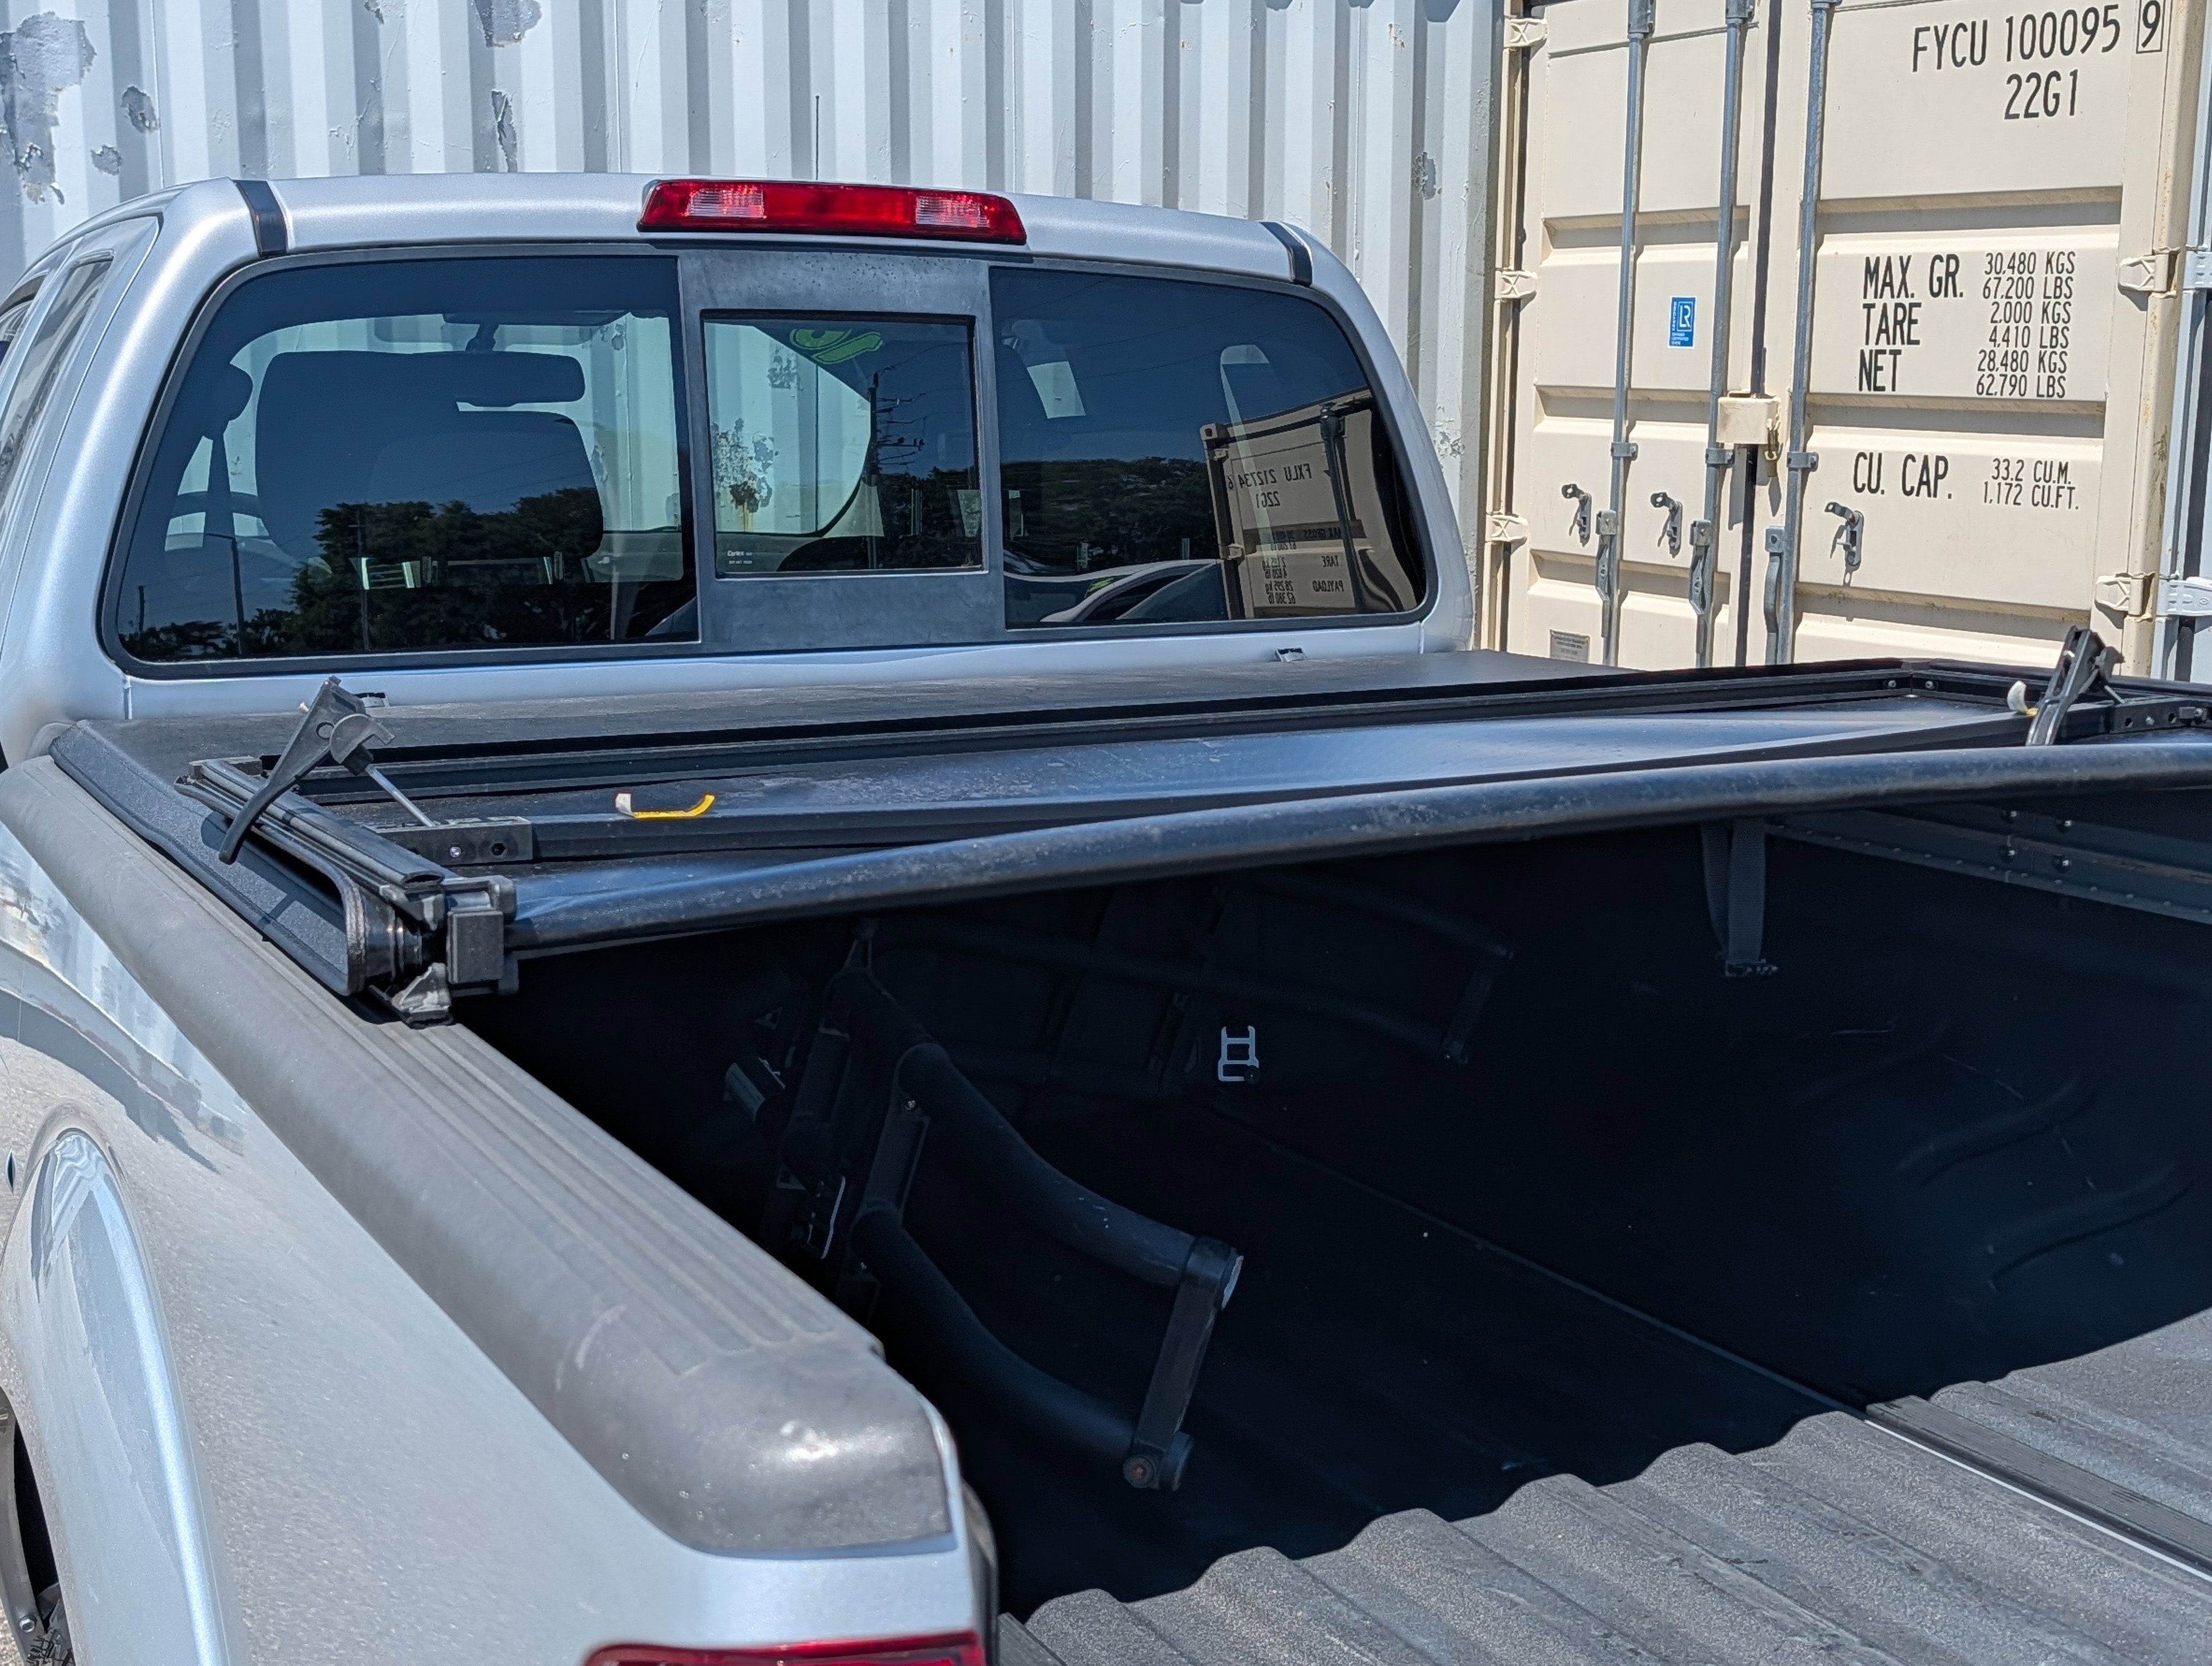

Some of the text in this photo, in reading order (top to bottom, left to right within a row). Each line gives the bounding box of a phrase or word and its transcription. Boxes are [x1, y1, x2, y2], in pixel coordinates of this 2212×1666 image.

[1913, 0, 2161, 72] FYCU 100095 9
[2004, 69, 2078, 120] 22G1
[1863, 254, 1964, 299] MAX. GR.
[1984, 251, 2076, 275] 30,480 KGS
[1983, 277, 2074, 299] 67,200 LBS
[1862, 302, 1921, 345] TARE
[1990, 302, 2072, 324] 2,000 KGS
[1989, 325, 2069, 349] 4,410 LBS
[1859, 349, 1901, 392] NET
[1978, 350, 2068, 374] 28,480 KGS
[1976, 375, 2066, 399] 62,790 LBS
[1853, 452, 1952, 499] CU. CAP.
[1991, 458, 2071, 484] 33.2 CU.M.
[1984, 482, 2079, 510] 1,172 CU.FT.
